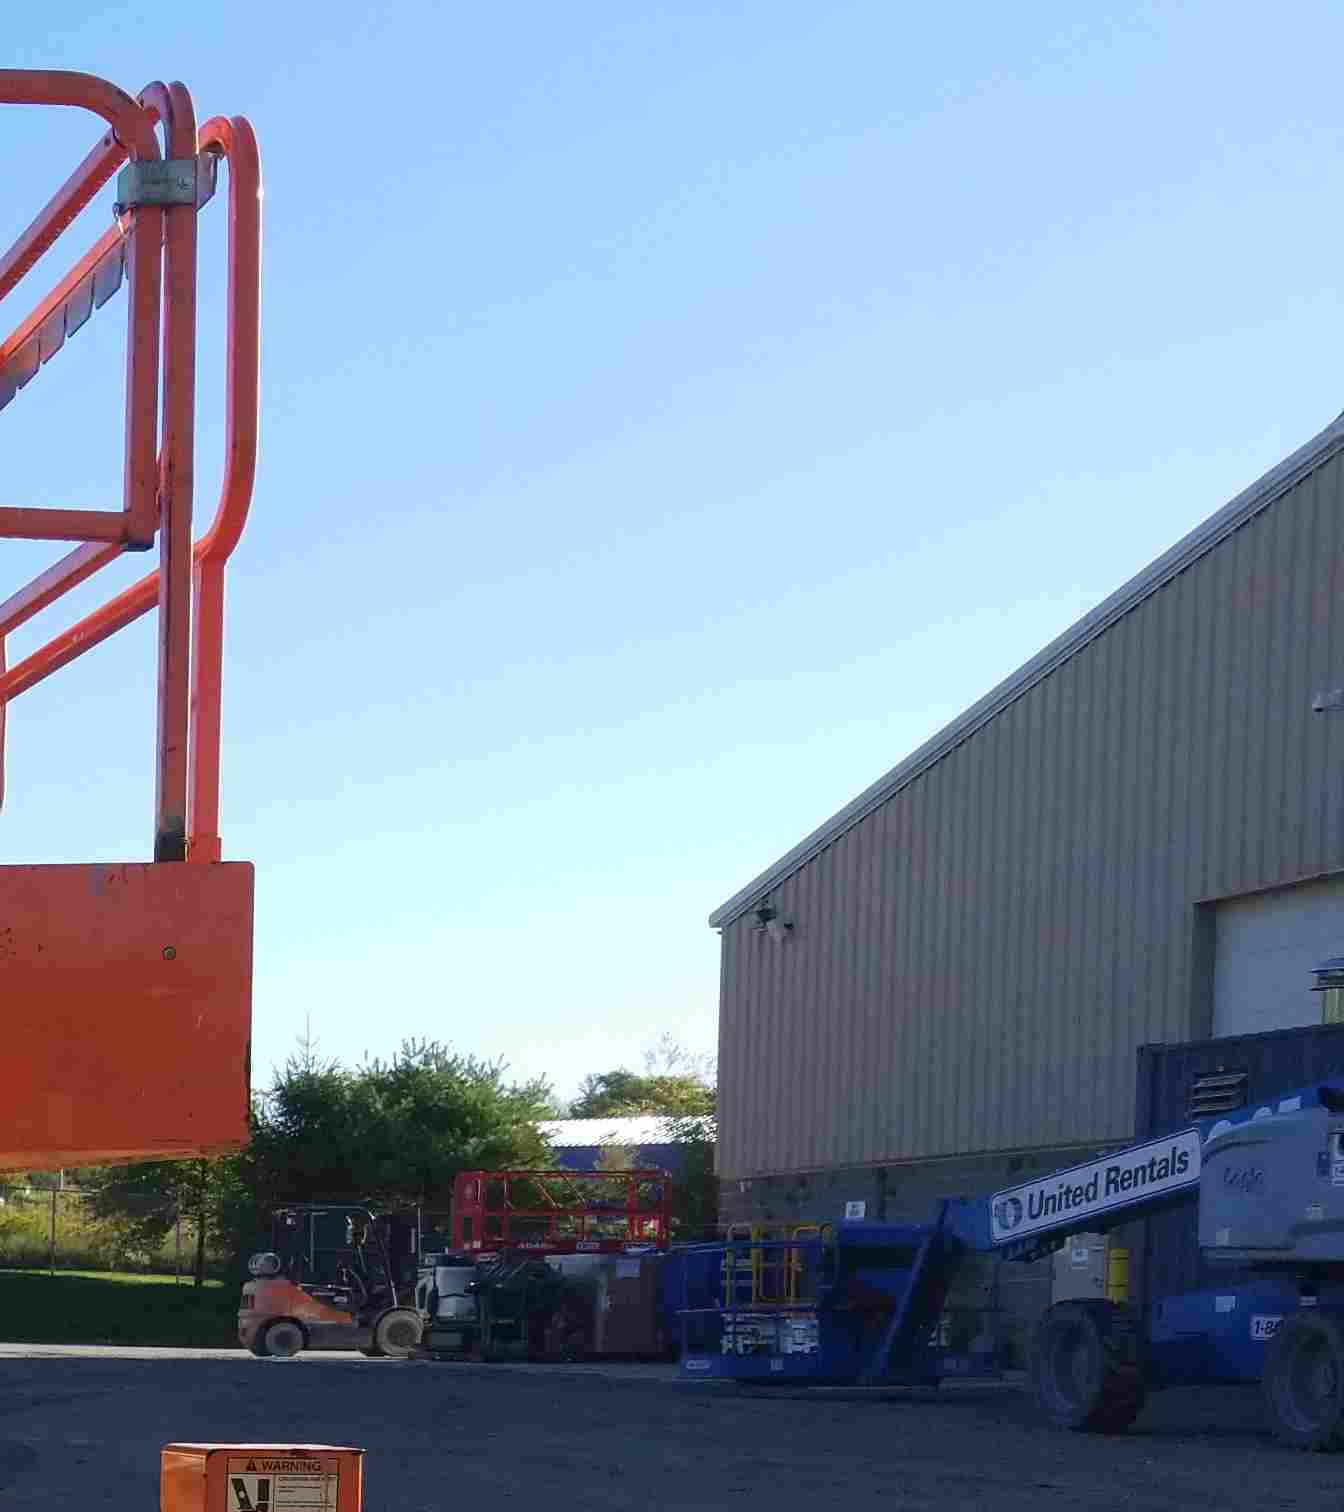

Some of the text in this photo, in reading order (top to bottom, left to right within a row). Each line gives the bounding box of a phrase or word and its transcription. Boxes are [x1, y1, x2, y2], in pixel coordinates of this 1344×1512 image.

[1027, 1172, 1098, 1220] United
[1104, 1146, 1189, 1199] Rentals
[262, 1460, 321, 1472] WARNING
